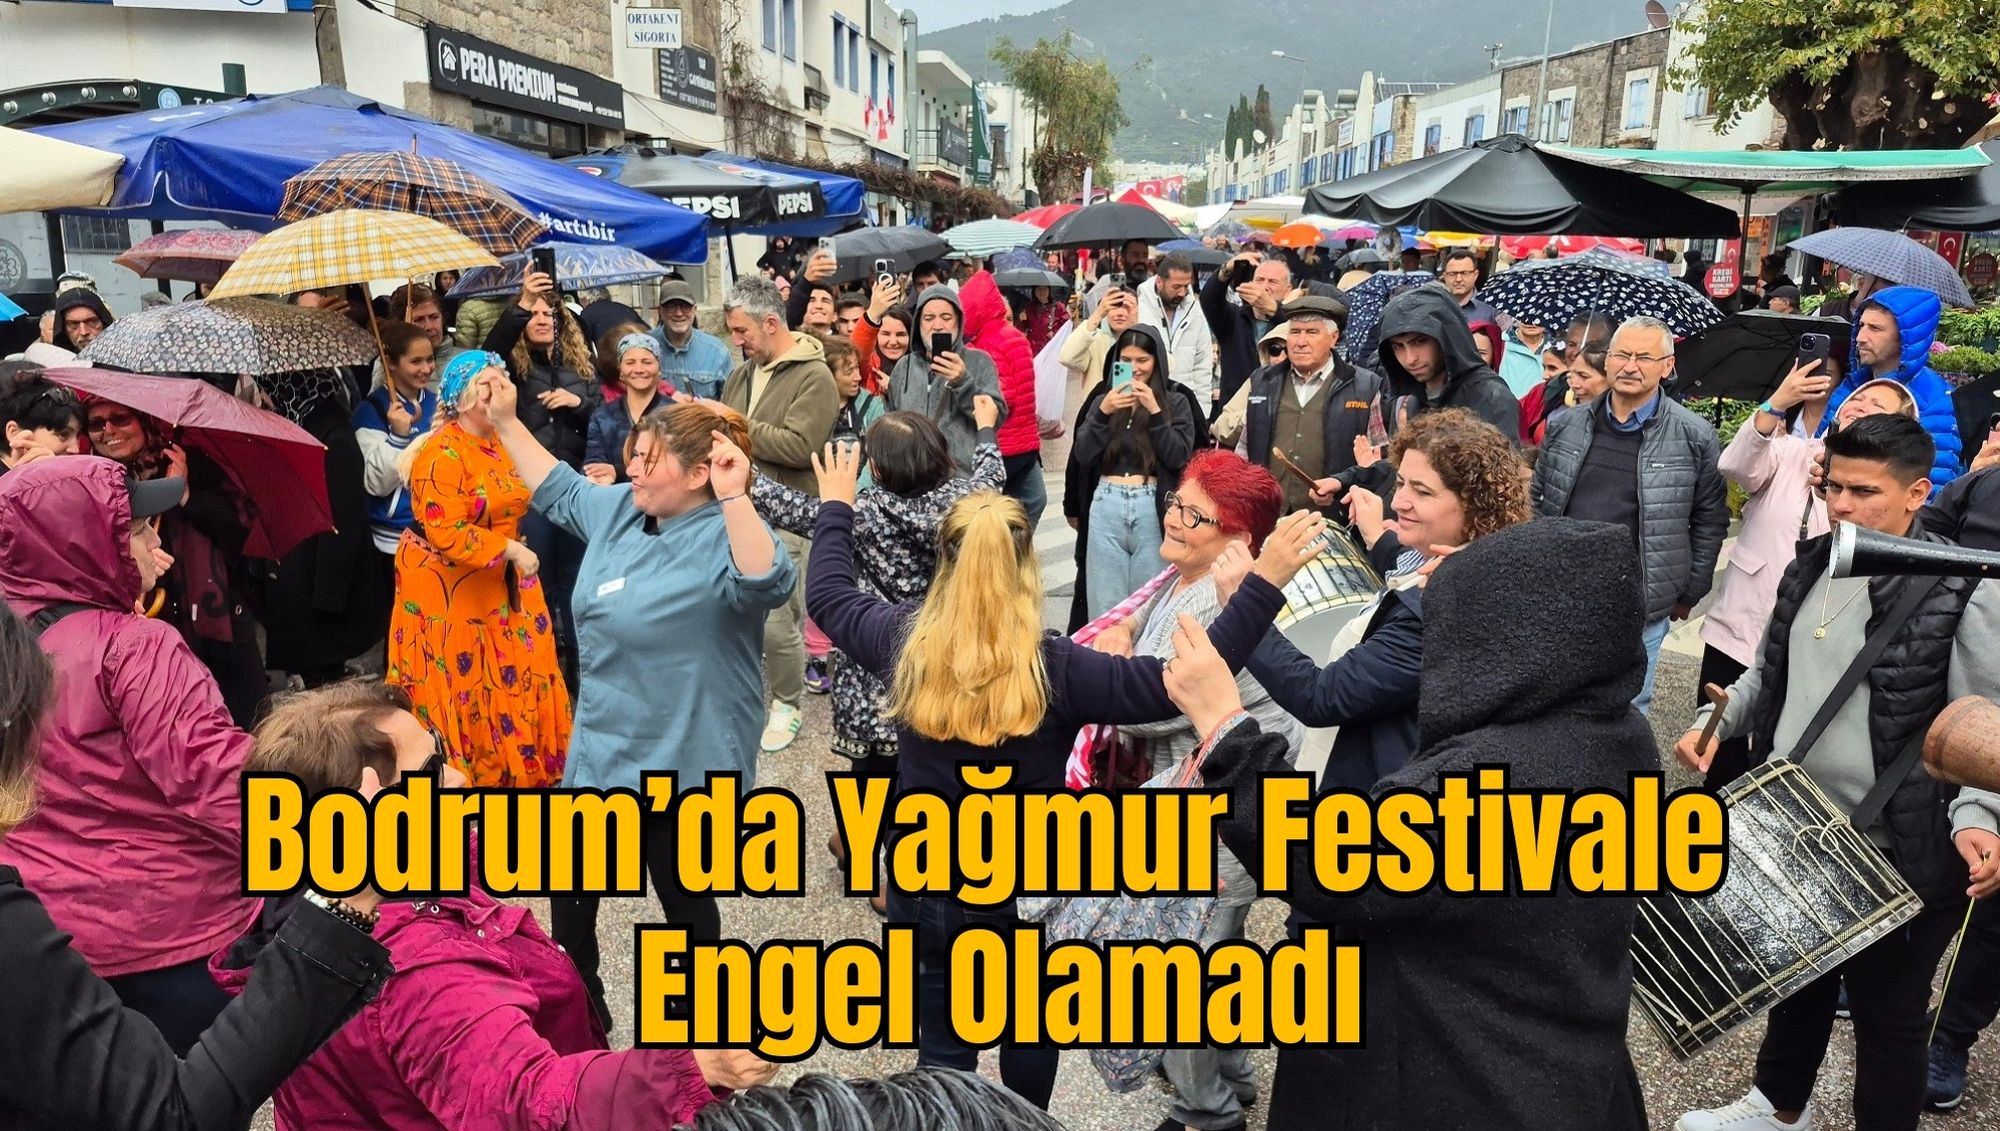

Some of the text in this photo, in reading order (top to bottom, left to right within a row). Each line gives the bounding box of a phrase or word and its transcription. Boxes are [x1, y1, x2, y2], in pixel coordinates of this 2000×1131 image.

[627, 13, 679, 24] ORTAKENT
[460, 47, 557, 103] PERA PREMIUM
[777, 191, 813, 216] PEPSI
[1711, 275, 1732, 283] KARTI
[1345, 401, 1369, 410] STIHL
